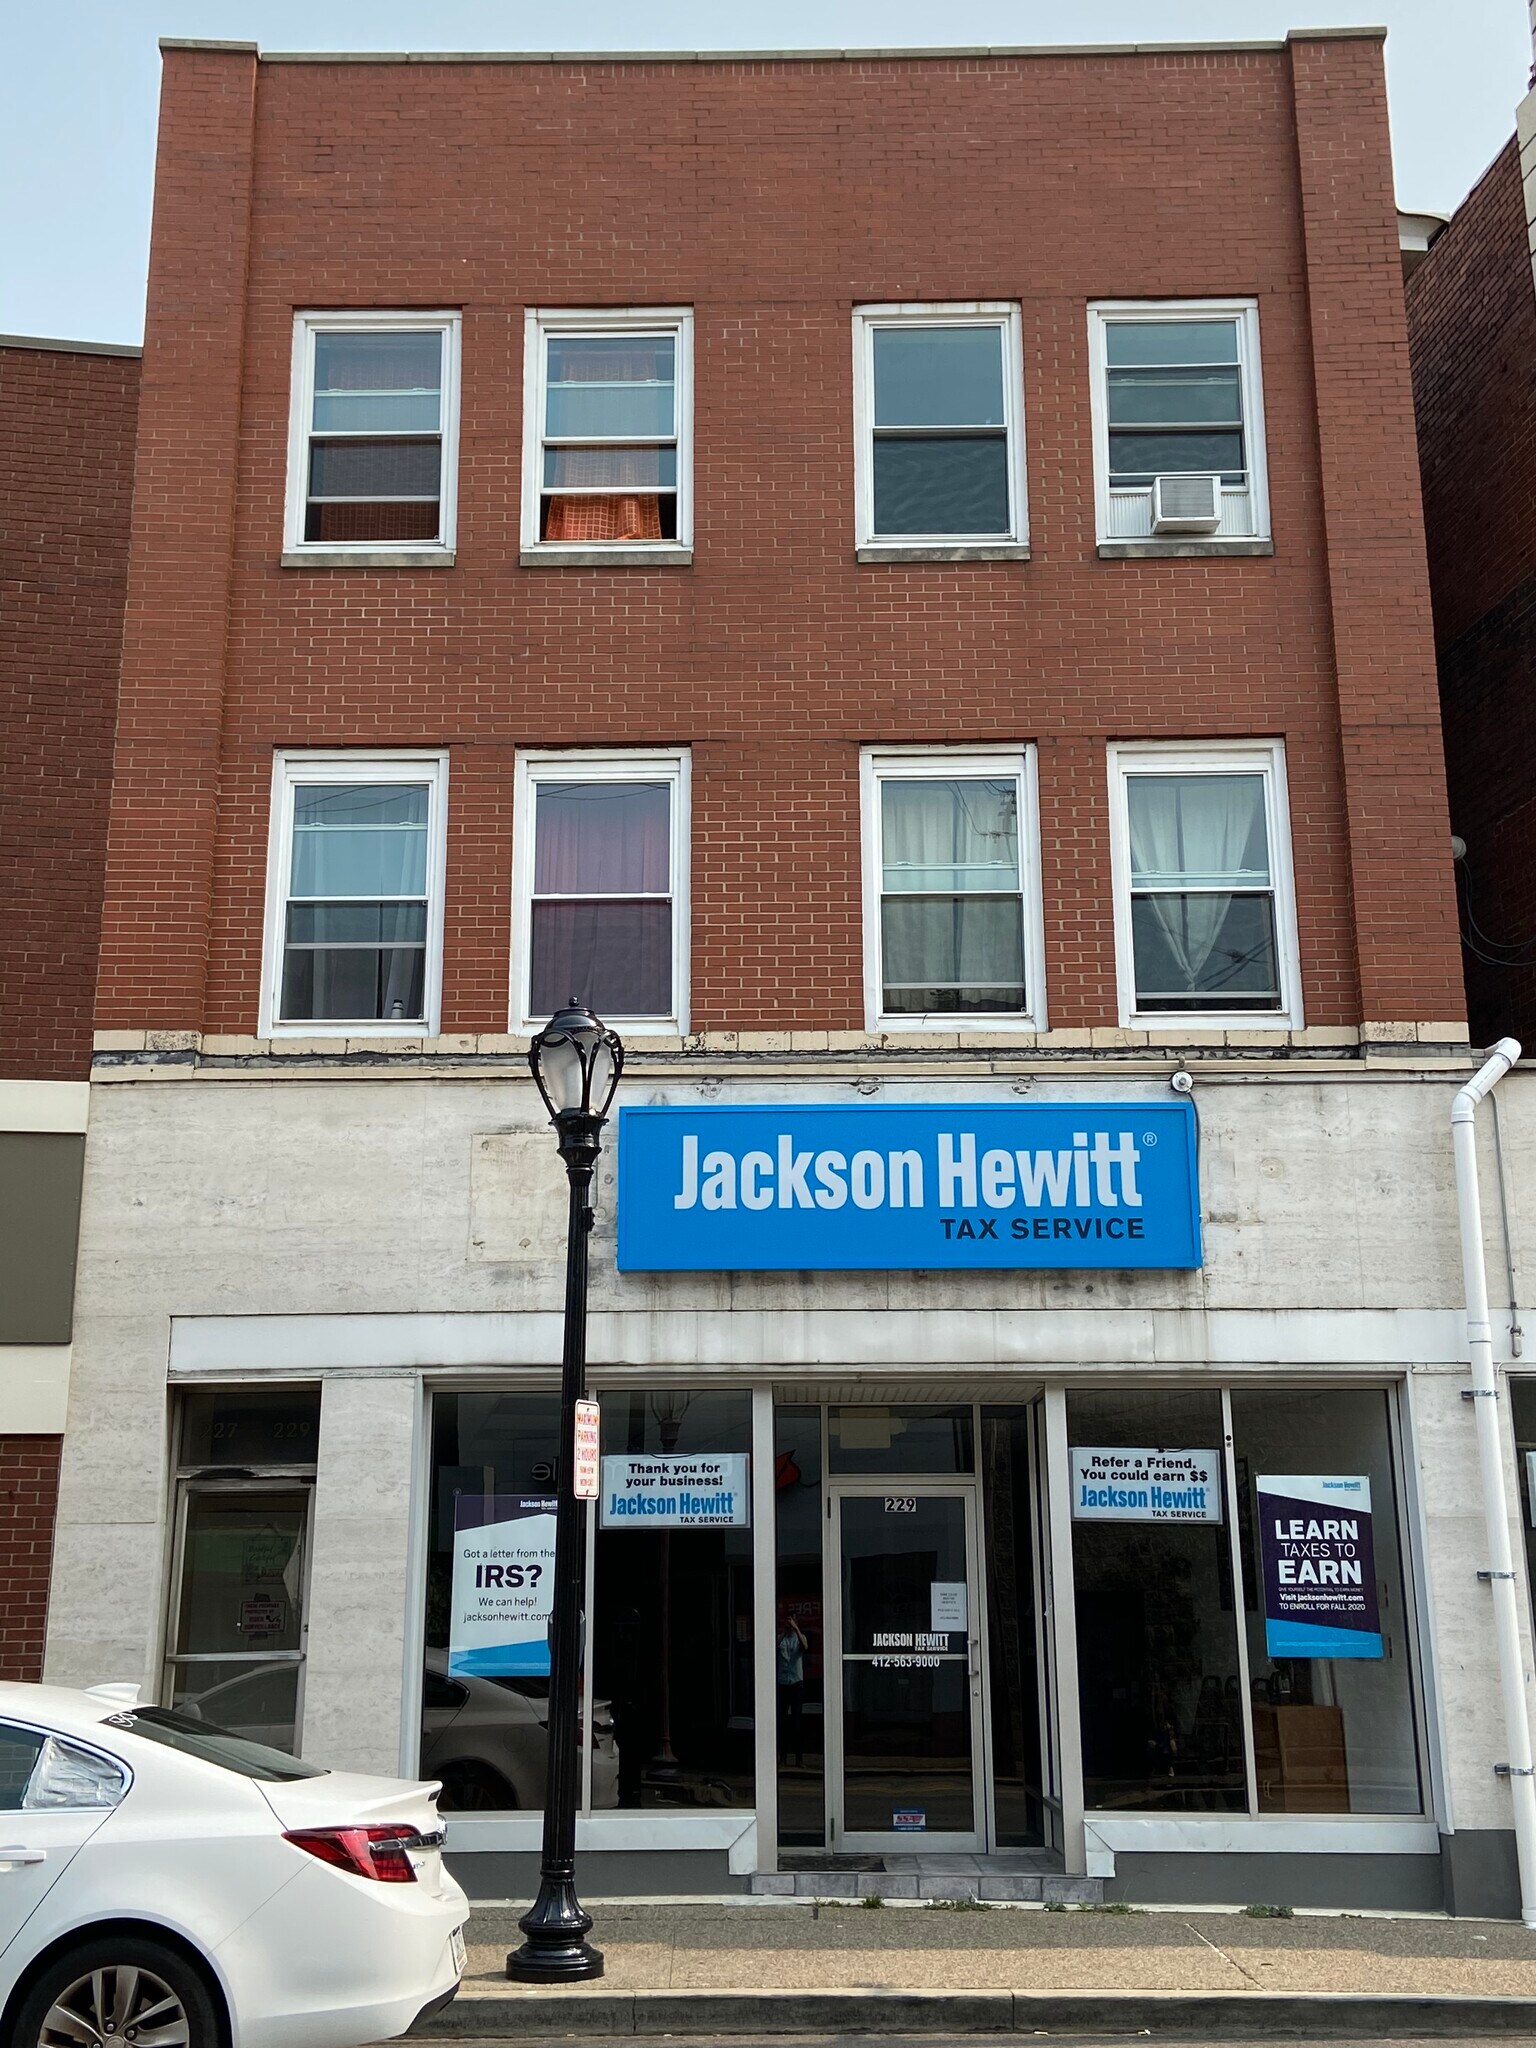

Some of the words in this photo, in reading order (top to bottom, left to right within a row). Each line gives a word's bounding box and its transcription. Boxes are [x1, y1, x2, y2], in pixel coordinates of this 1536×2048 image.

[674, 1134, 924, 1211] Jackson
[940, 1218, 999, 1239] TAX
[1011, 1217, 1145, 1239] SERVICE
[629, 1463, 669, 1474] Thank
[673, 1464, 697, 1475] you
[701, 1463, 721, 1473] for
[1091, 1456, 1130, 1467] Refer
[1134, 1459, 1142, 1467] a
[1147, 1457, 1196, 1469] Friend.
[626, 1478, 656, 1488] your
[660, 1475, 723, 1487] business!
[1080, 1469, 1106, 1480] You
[1111, 1470, 1149, 1481] could
[1153, 1472, 1185, 1481] earn
[1190, 1470, 1208, 1483] $$
[1080, 1485, 1147, 1507] Jackson
[1151, 1486, 1206, 1508] Hewitt
[609, 1493, 676, 1515] Jackson
[680, 1492, 734, 1514] Hewitt
[886, 1498, 915, 1511] 229
[1275, 1519, 1359, 1540] LEARN
[463, 1549, 480, 1558] Got
[490, 1549, 514, 1558] letter
[516, 1549, 538, 1558] from
[540, 1549, 555, 1558] the
[1281, 1543, 1330, 1557] TAXES
[1334, 1543, 1356, 1557] TO
[475, 1564, 543, 1588] IRS?
[1278, 1559, 1362, 1585] EARN
[478, 1597, 494, 1606] We
[514, 1597, 537, 1608] help!
[1279, 1593, 1297, 1601] Visit
[1297, 1593, 1364, 1602] jacksonhewitt.com
[1330, 1603, 1347, 1611] FALL
[1347, 1603, 1366, 1611] 2020
[463, 1612, 550, 1623] jacksonhewitt.com
[872, 1633, 913, 1646] JACKSON
[914, 1633, 949, 1646] HEWITT
[871, 1655, 940, 1668] 412-563-9000
